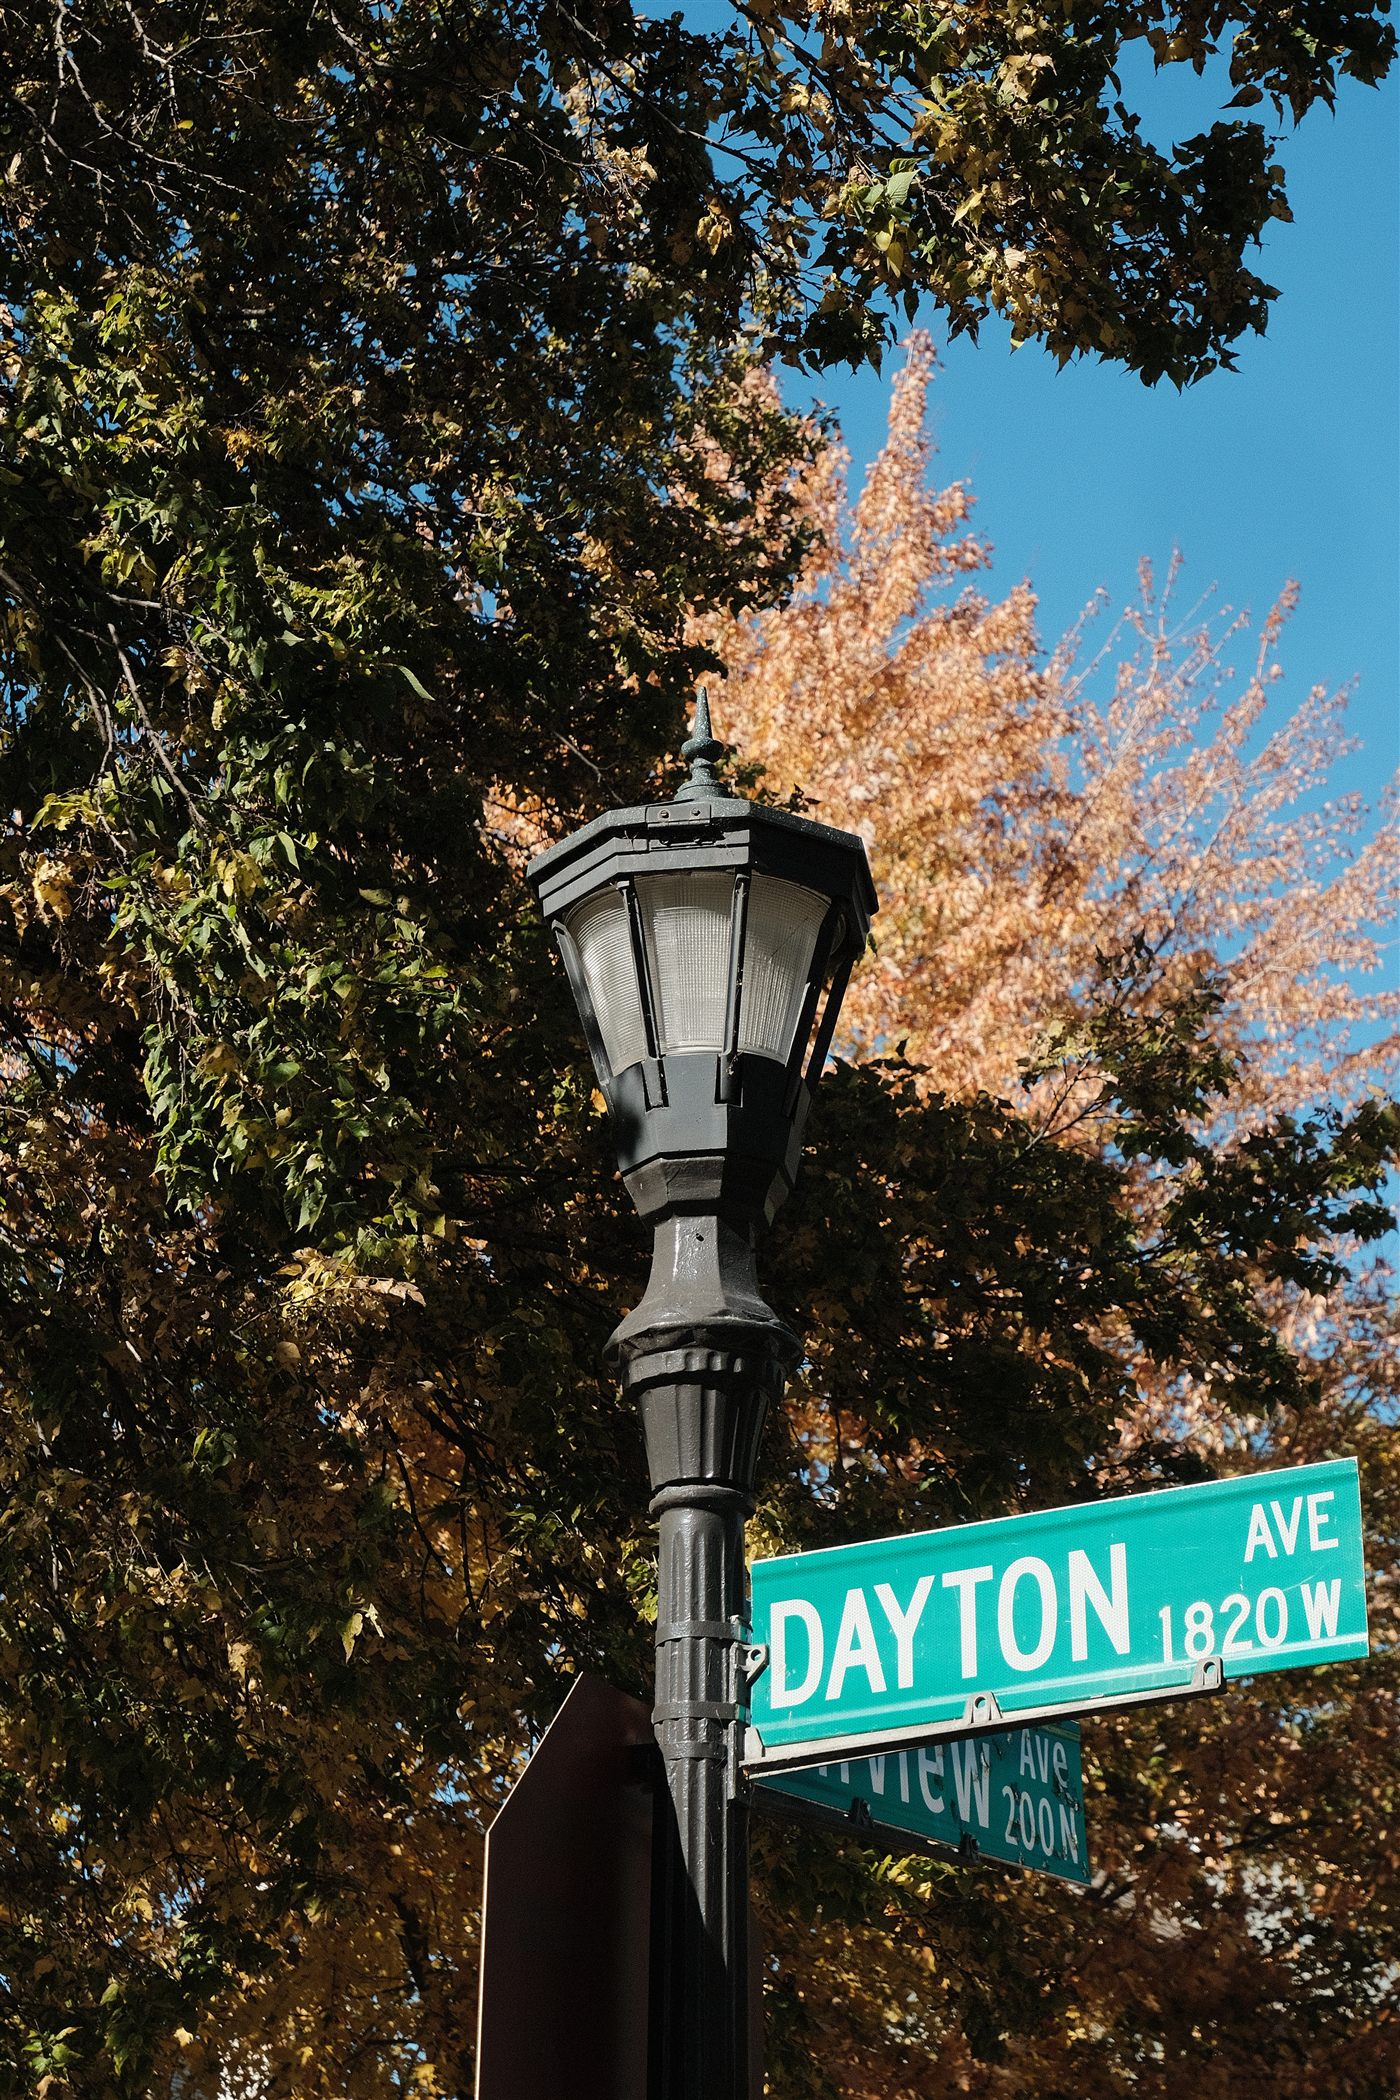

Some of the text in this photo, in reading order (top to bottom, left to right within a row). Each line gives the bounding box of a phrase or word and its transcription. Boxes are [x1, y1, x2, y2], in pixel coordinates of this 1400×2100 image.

[1243, 1490, 1340, 1563] AVE
[767, 1542, 1131, 1710] DAYTON
[1157, 1577, 1343, 1665] 1820 W
